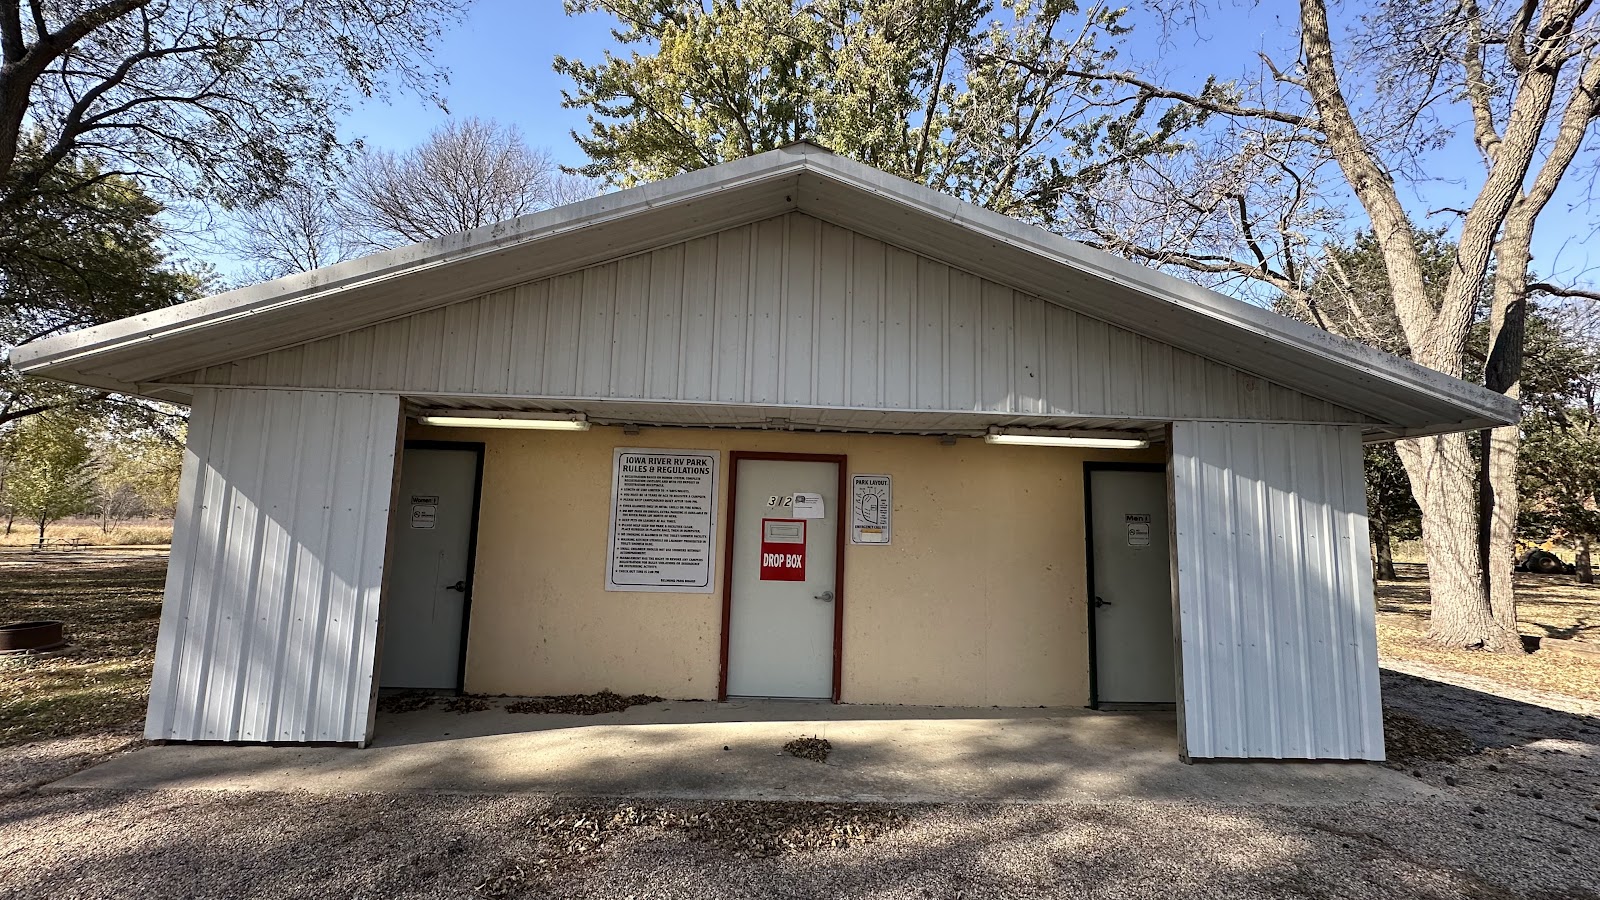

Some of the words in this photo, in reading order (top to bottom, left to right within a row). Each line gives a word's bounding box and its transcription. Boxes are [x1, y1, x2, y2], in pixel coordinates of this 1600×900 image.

[657, 466, 709, 474] REGULATIONS
[769, 496, 792, 506] 312
[763, 553, 784, 568] DROP
[786, 554, 802, 568] BOX
